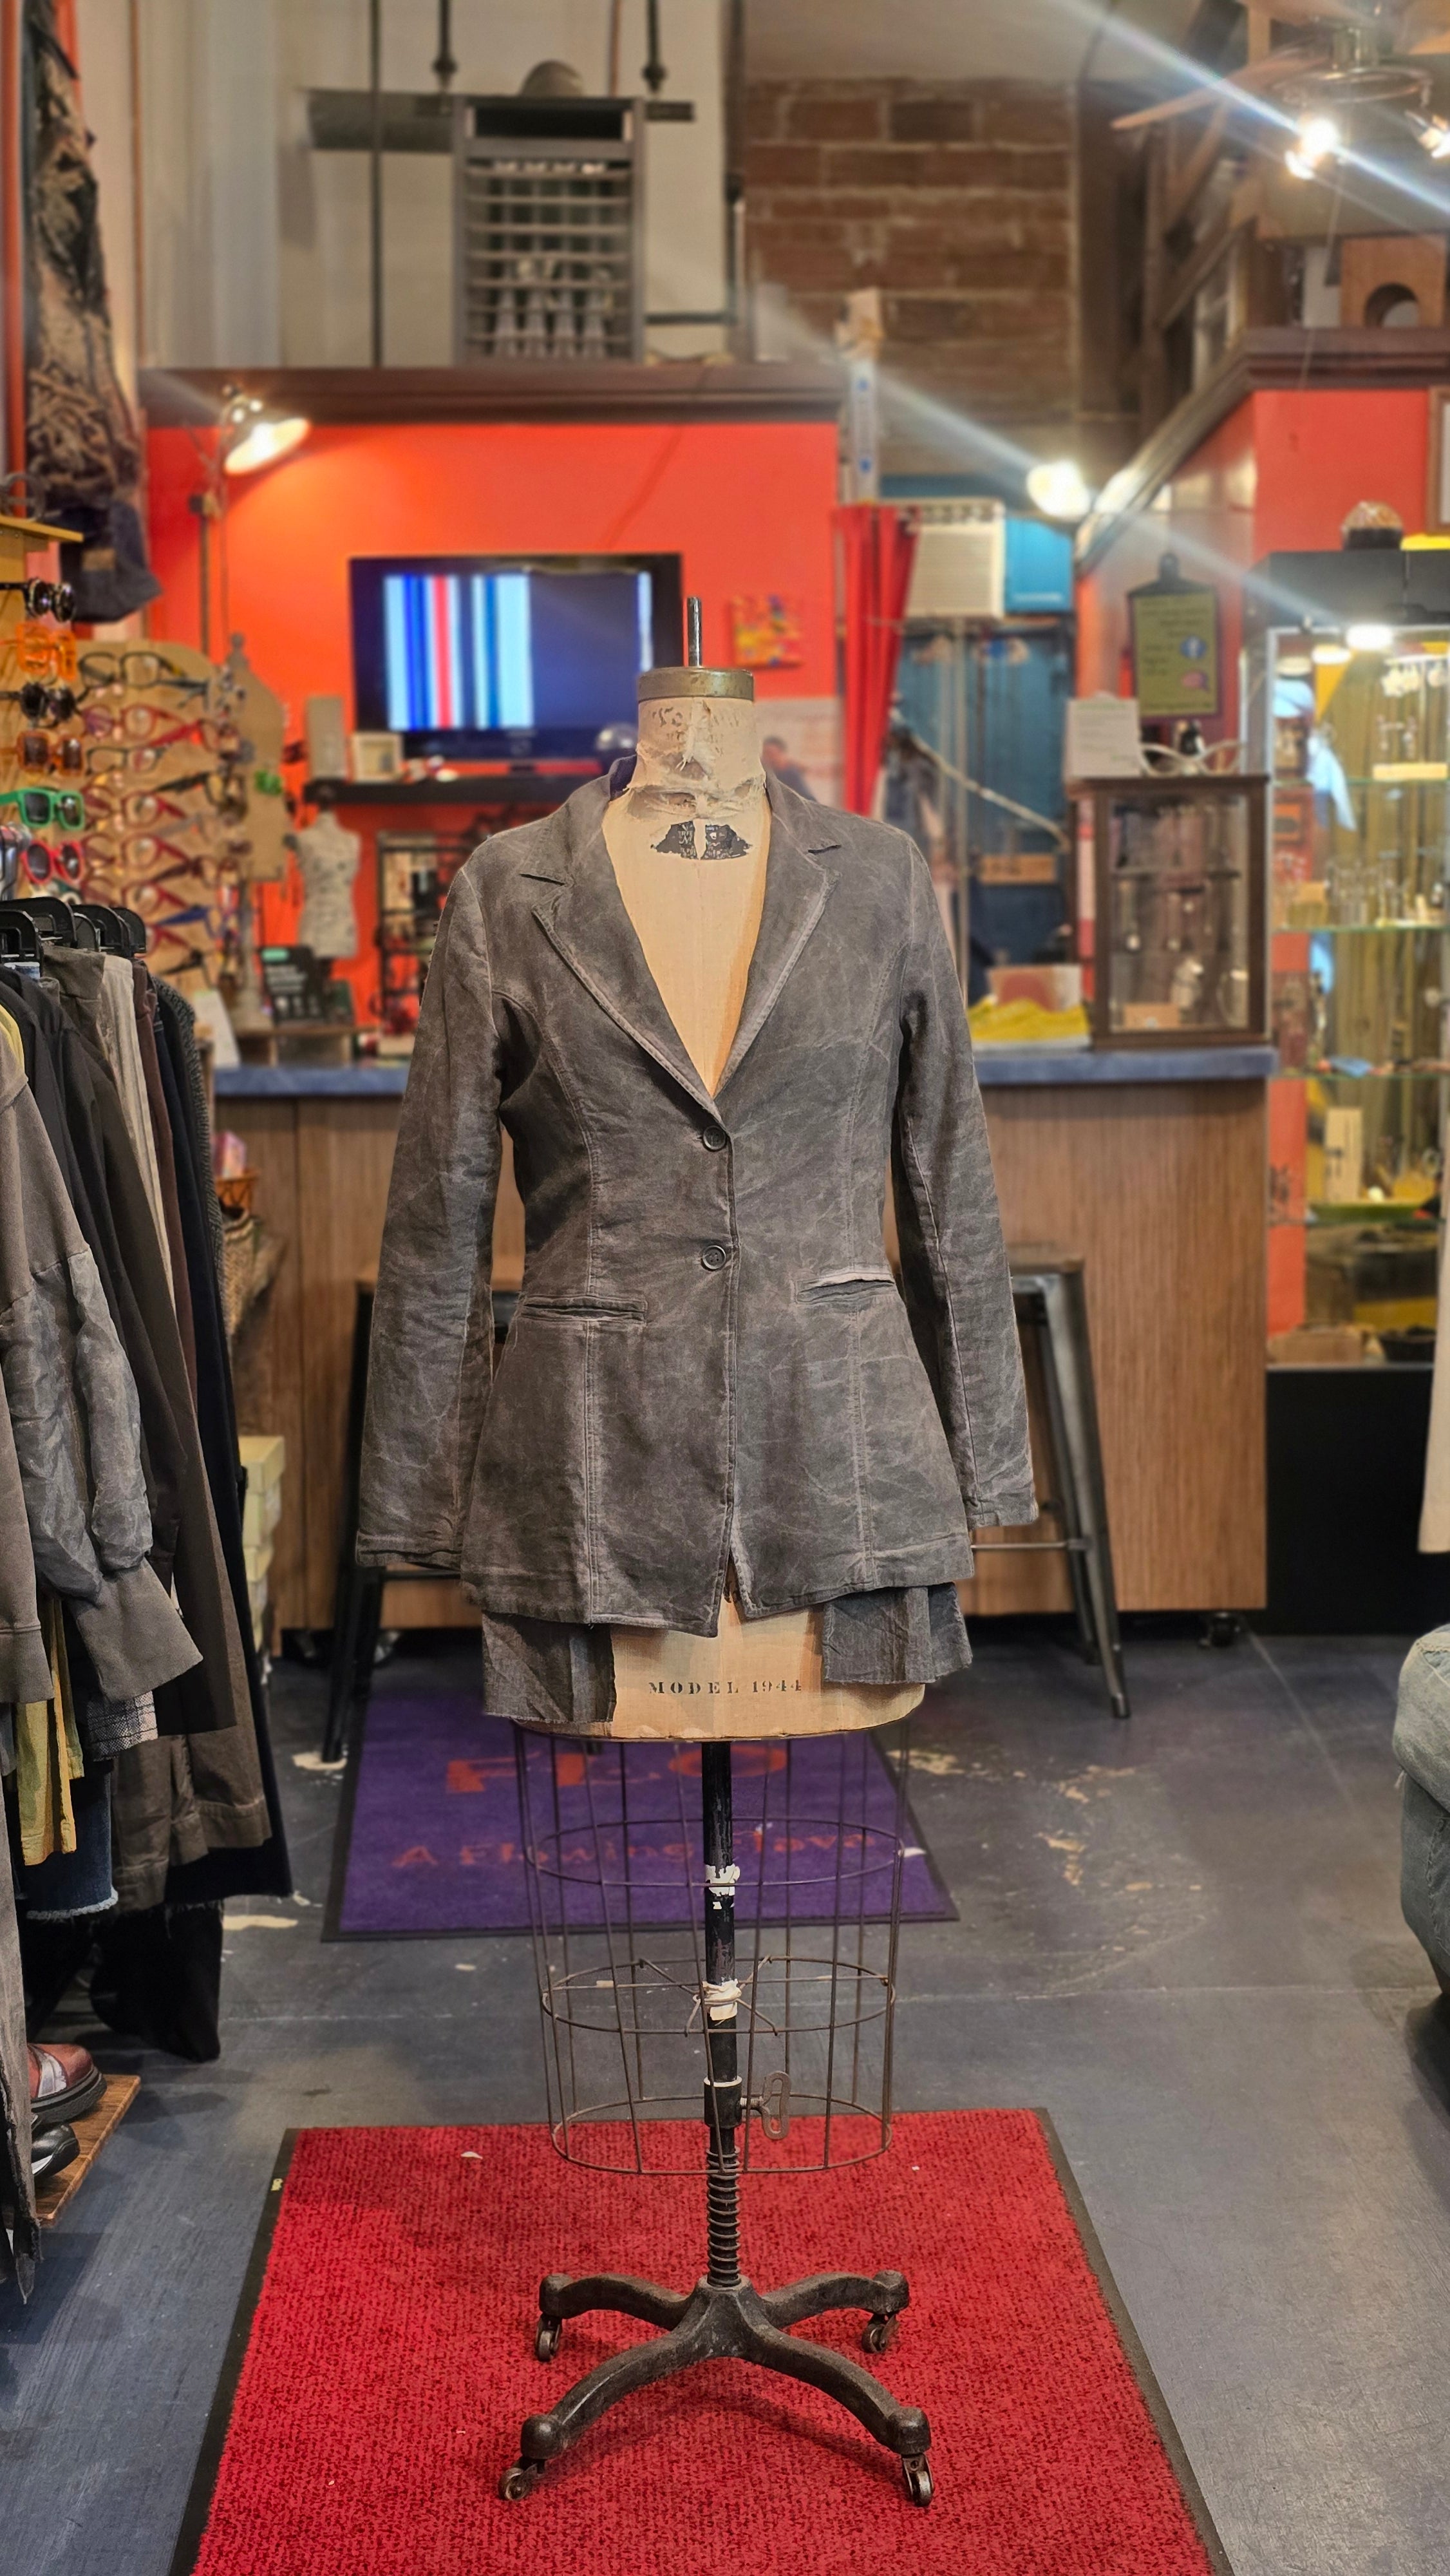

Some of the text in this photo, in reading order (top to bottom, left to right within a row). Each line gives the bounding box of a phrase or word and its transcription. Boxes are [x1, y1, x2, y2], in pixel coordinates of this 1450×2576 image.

[648, 1679, 803, 1695] MODEL 1944
[391, 1844, 438, 1868] A
